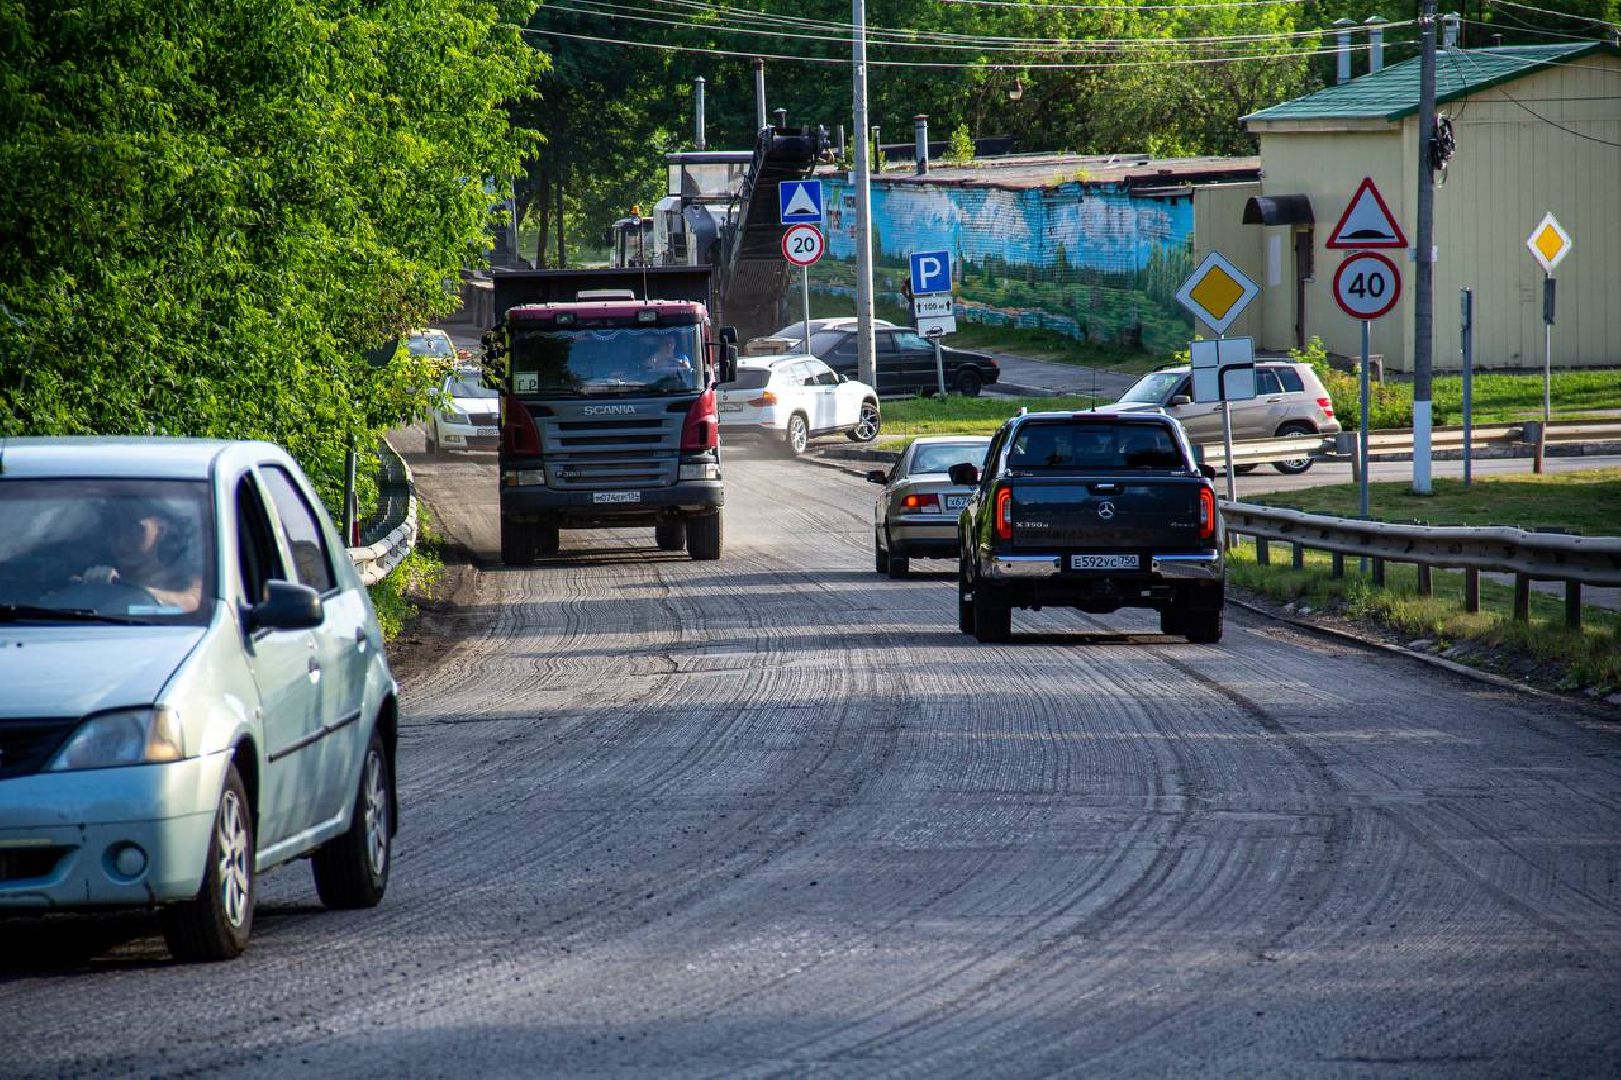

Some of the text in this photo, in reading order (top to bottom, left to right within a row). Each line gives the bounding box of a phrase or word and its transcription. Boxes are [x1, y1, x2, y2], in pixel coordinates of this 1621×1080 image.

[794, 237, 815, 253] 20
[919, 257, 941, 288] P
[1348, 272, 1385, 298] 40
[584, 405, 636, 415] SCANIA
